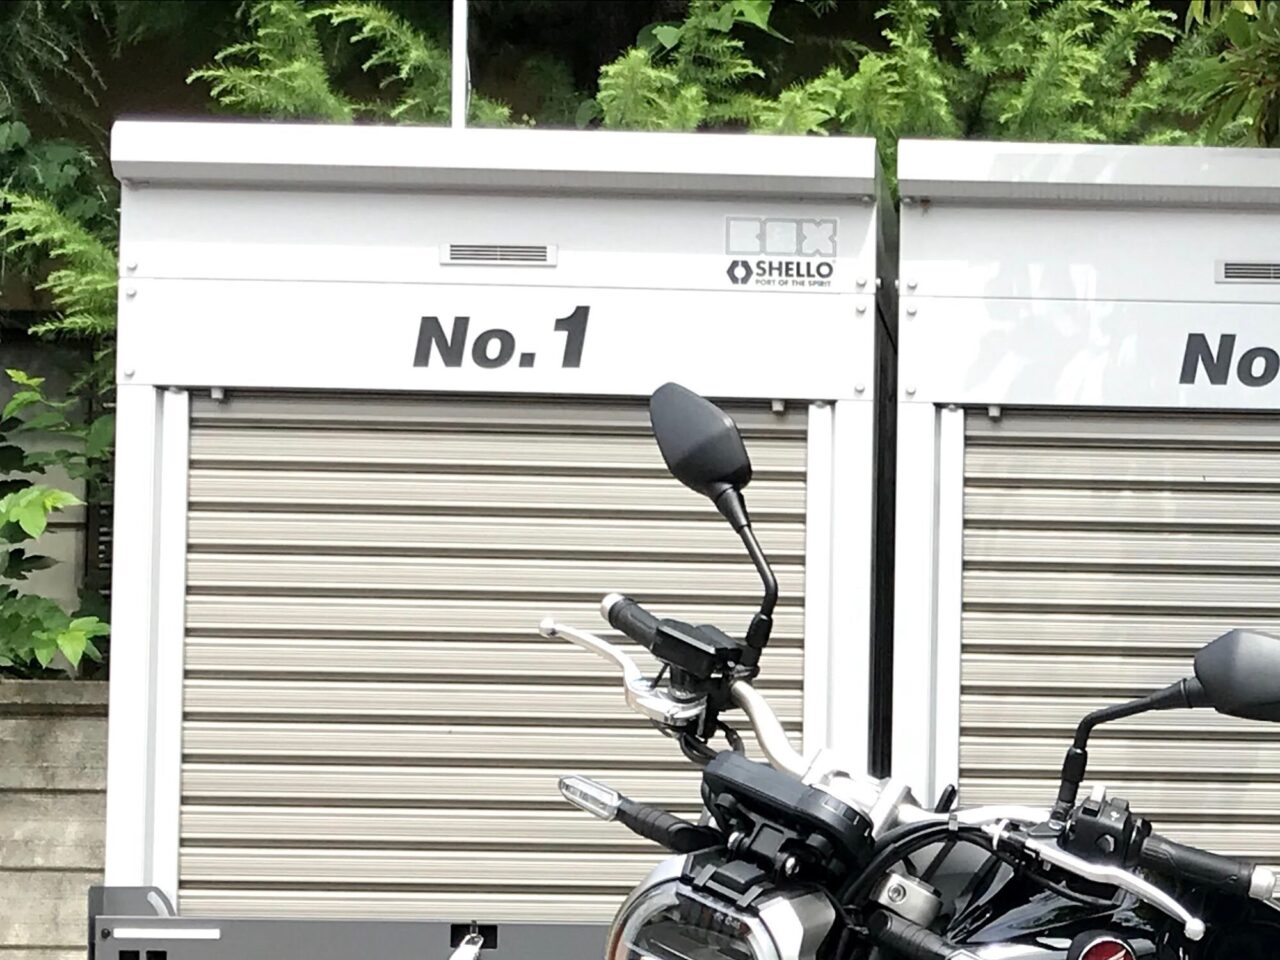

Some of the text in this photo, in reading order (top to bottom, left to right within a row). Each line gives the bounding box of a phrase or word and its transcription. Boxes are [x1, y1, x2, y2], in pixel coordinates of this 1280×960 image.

[756, 260, 833, 279] SHELLO
[755, 278, 832, 288] PORT OF THE SPIRIT
[412, 305, 591, 369] No.1
